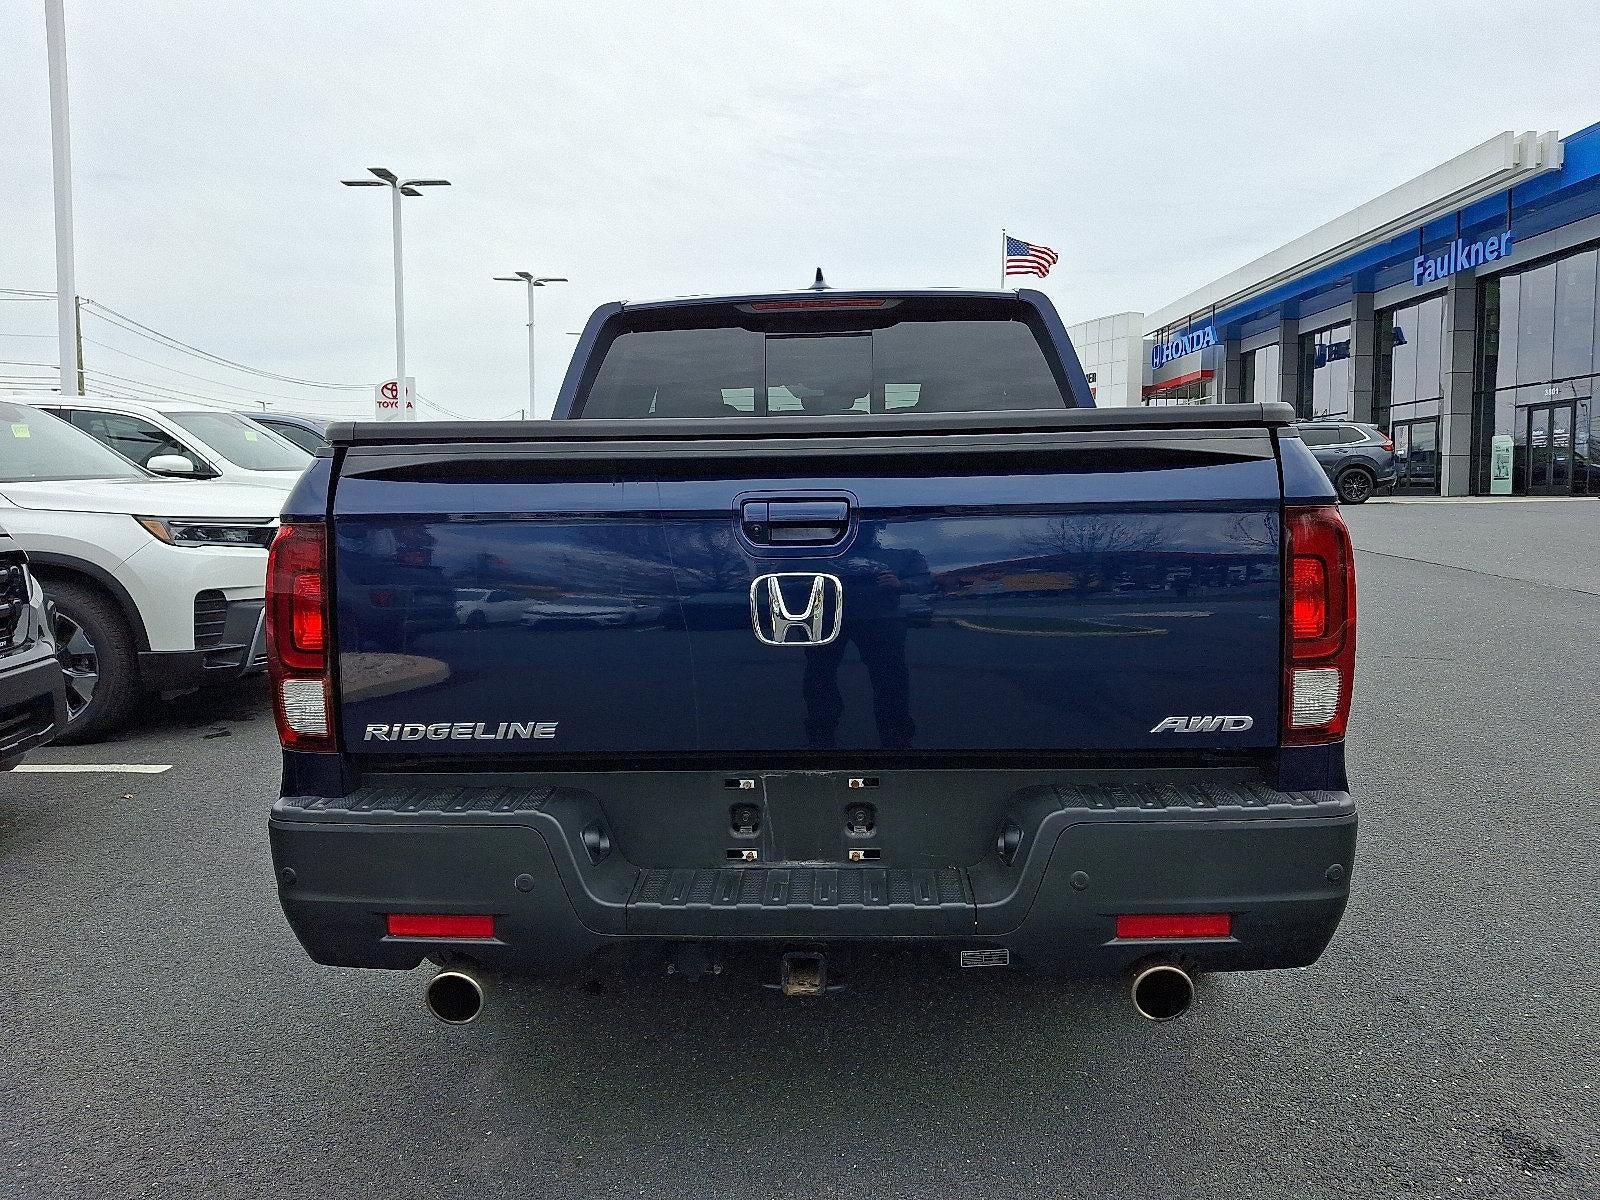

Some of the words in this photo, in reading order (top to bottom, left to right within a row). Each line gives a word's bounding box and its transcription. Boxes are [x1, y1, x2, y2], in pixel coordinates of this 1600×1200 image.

[1413, 230, 1511, 287] Faulkner
[1161, 325, 1217, 362] HONDA
[376, 400, 414, 409] TOYA
[363, 721, 559, 742] RIDGELINE
[1149, 715, 1254, 733] AWD
